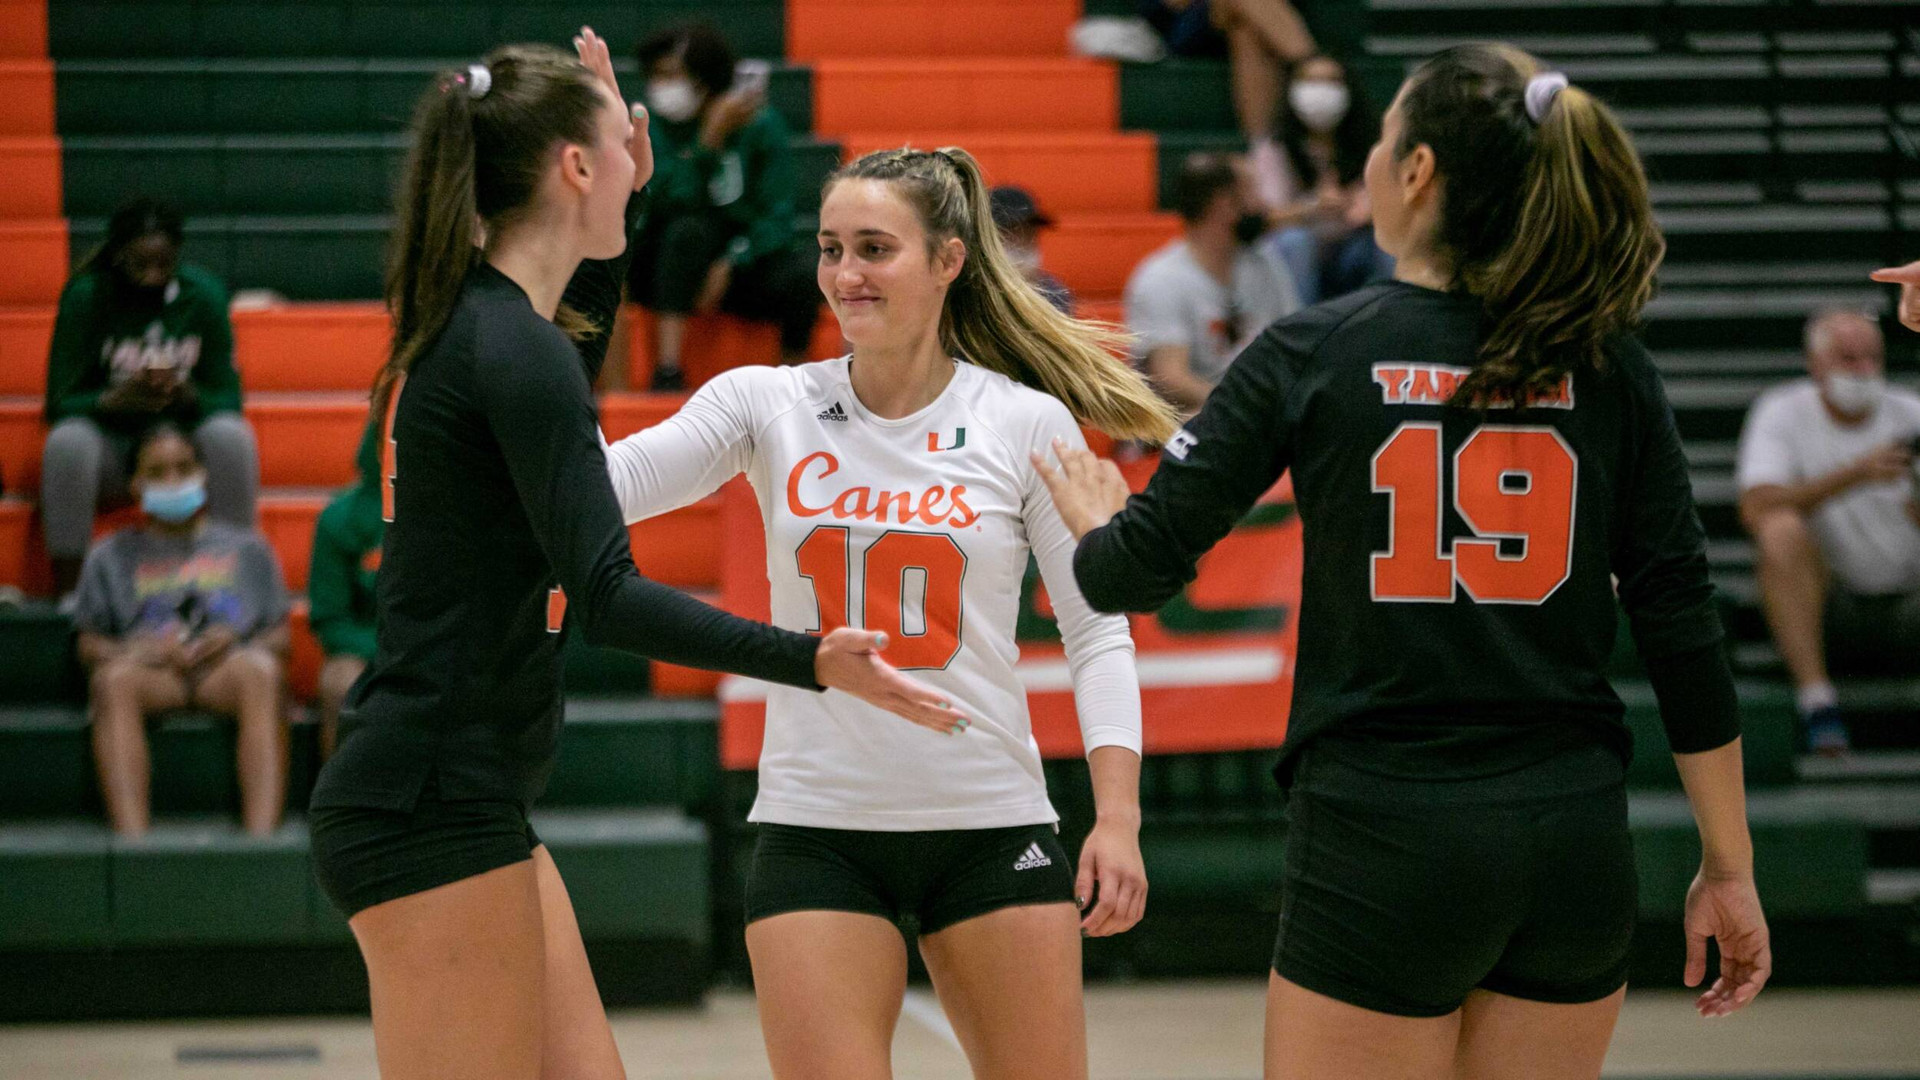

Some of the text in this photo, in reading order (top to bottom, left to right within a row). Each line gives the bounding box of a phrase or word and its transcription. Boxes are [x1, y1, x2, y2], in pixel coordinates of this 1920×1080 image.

[927, 427, 966, 452] U
[787, 451, 981, 529] Canes
[1370, 420, 1579, 605] 19
[795, 524, 969, 671] 10
[1013, 857, 1052, 871] adidas
